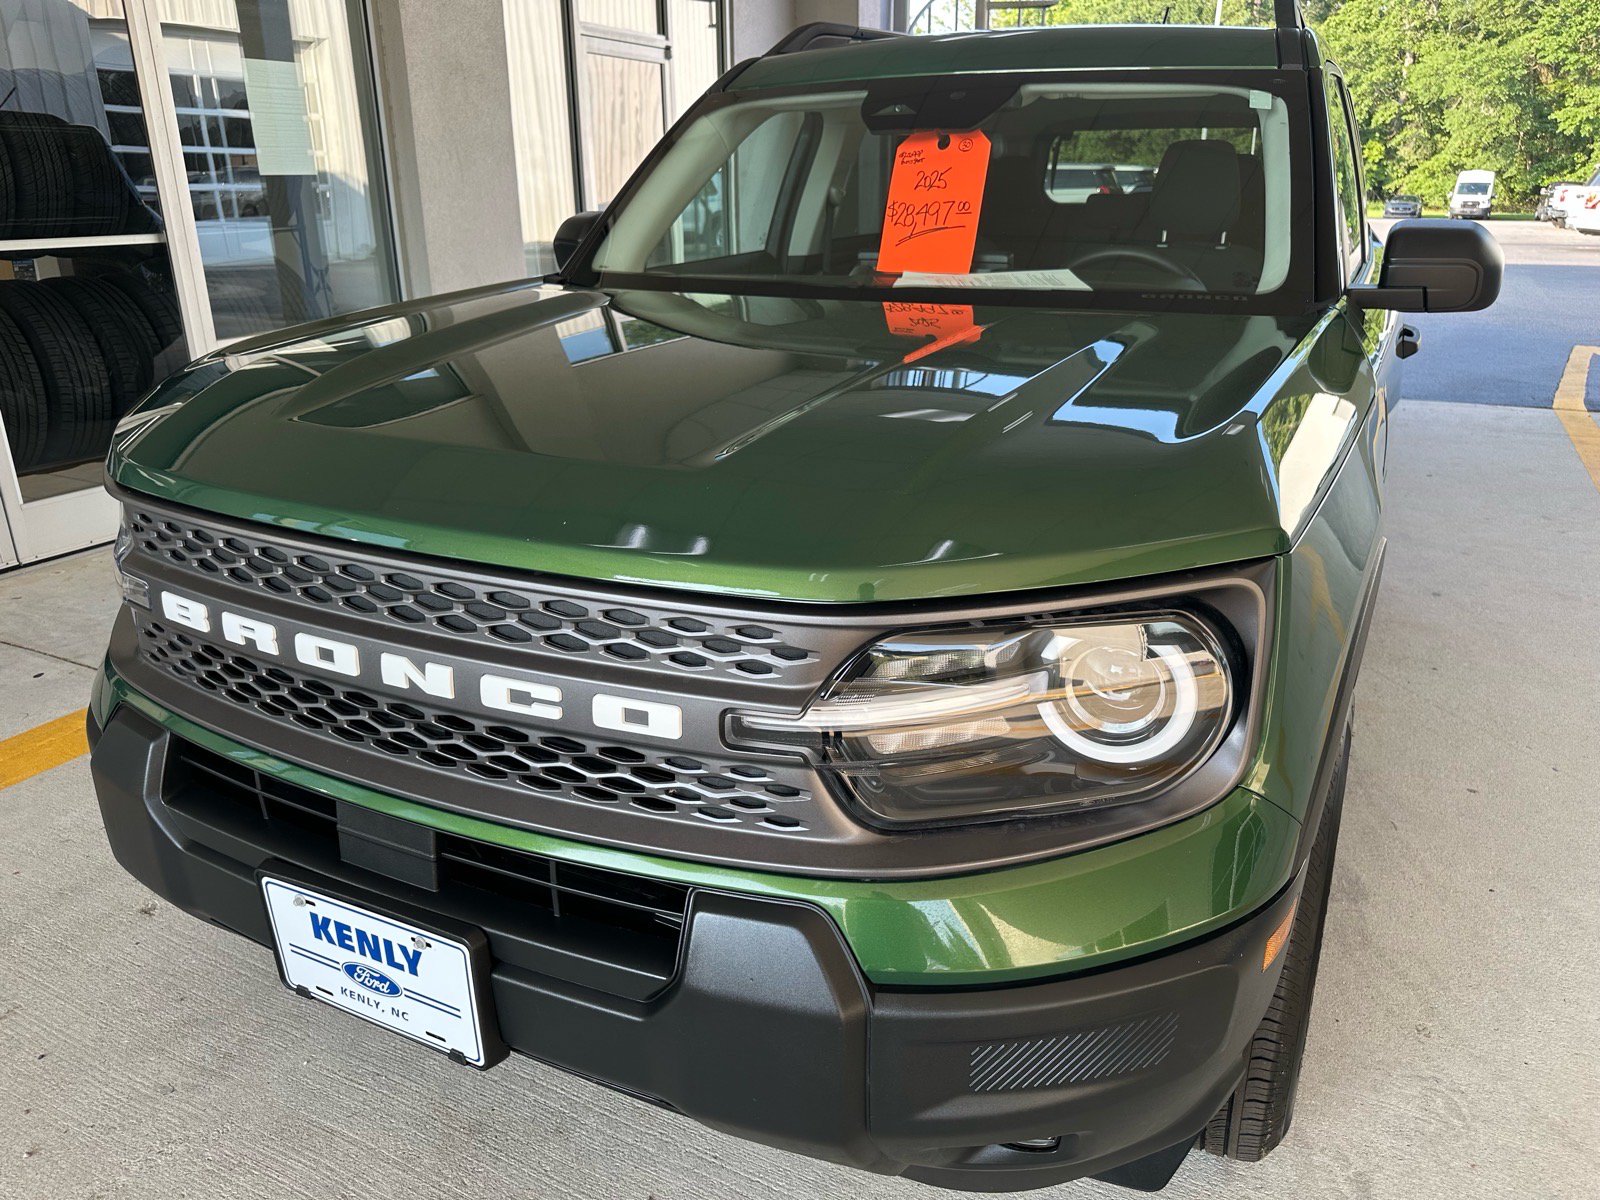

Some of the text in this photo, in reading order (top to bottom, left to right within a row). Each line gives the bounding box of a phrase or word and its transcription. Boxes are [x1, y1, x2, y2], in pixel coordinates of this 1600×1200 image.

[914, 167, 952, 191] 2025
[161, 591, 682, 740] BRONCO
[309, 911, 422, 978] KENLY
[353, 965, 391, 993] Ford
[391, 1007, 409, 1021] NC
